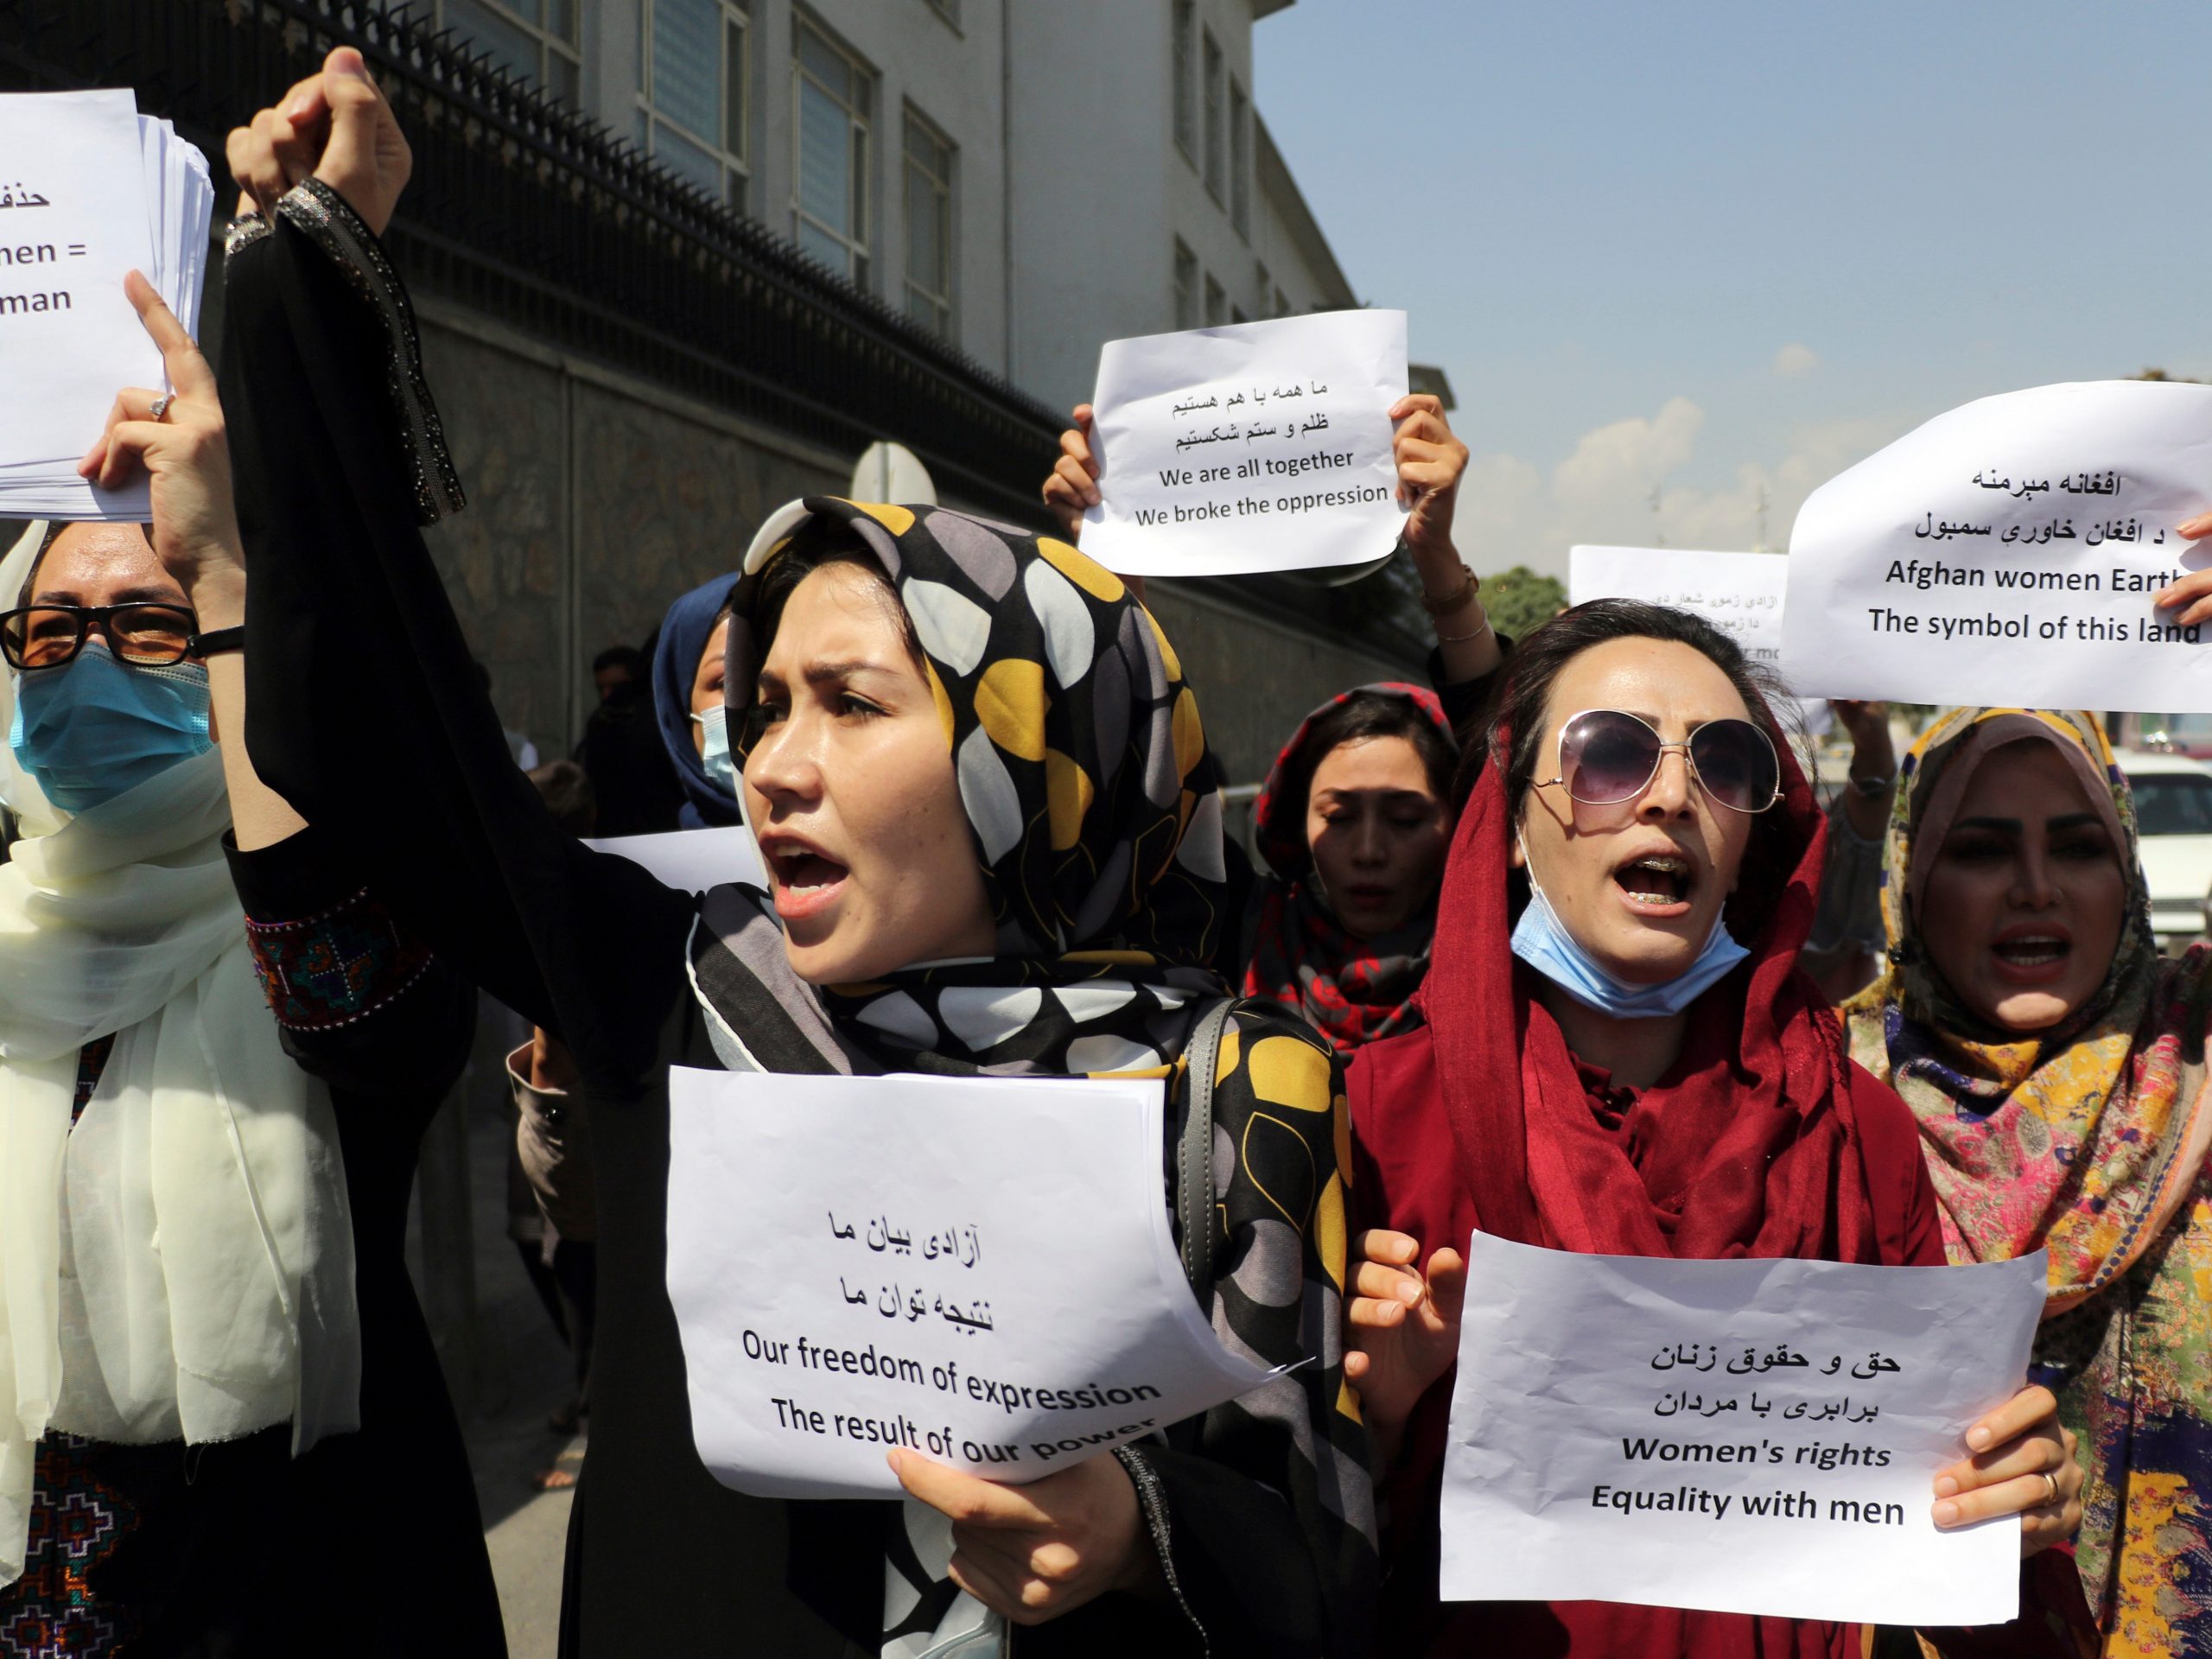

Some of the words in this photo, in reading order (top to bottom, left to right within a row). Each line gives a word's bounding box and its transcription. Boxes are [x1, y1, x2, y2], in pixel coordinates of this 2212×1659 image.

[1254, 388, 1266, 405] با
[1272, 385, 1303, 400] همه
[1312, 381, 1327, 394] ما
[1172, 397, 1218, 420] هستیم
[1226, 393, 1245, 413] هم
[1176, 424, 1239, 454] شکستیم
[1246, 423, 1277, 448] ستم
[1285, 424, 1294, 438] و
[1300, 412, 1329, 439] ظلم
[1160, 469, 1192, 486] We
[1199, 467, 1230, 482] are
[1237, 459, 1260, 478] all
[1266, 451, 1353, 476] together
[2059, 471, 2121, 496] افغانه
[1135, 509, 1167, 526] We
[1174, 501, 1230, 522] broke
[1237, 497, 1269, 515] the
[1277, 486, 1388, 514] oppression
[1915, 512, 1992, 540] سمبول
[2086, 518, 2142, 546] افغان
[2152, 525, 2166, 545] د
[1885, 560, 1985, 589] Afghan
[1995, 570, 2100, 590] women
[1869, 608, 1918, 632] The
[1929, 613, 2029, 640] symbol
[2039, 616, 2069, 639] of
[2076, 617, 2128, 641] this
[2139, 617, 2201, 644] land
[829, 1211, 855, 1239] ما
[868, 1217, 911, 1255] بیان
[924, 1224, 980, 1268] آزادی
[841, 1277, 867, 1305] ما
[879, 1285, 926, 1322] توان
[934, 1294, 995, 1336] نتیجه
[743, 1330, 789, 1364] Our
[798, 1337, 925, 1385] freedom
[933, 1362, 957, 1394] of
[967, 1376, 1160, 1414] expression
[1651, 1344, 1717, 1372] زنان
[1726, 1344, 1809, 1375] حقوق
[1820, 1356, 1841, 1375] و
[1851, 1352, 1901, 1379] حق
[1655, 1390, 1738, 1417] مردان
[1751, 1392, 1771, 1419] با
[1783, 1396, 1878, 1423] برابری
[772, 1398, 825, 1433] The
[835, 1415, 919, 1449] result
[927, 1427, 952, 1458] of
[963, 1441, 1019, 1463] our
[1030, 1417, 1158, 1461] power
[1623, 1438, 1783, 1463] Women's
[1796, 1442, 1891, 1471] rights
[1592, 1486, 1732, 1520] Equality
[1742, 1491, 1816, 1518] with
[1830, 1501, 1904, 1525] men
